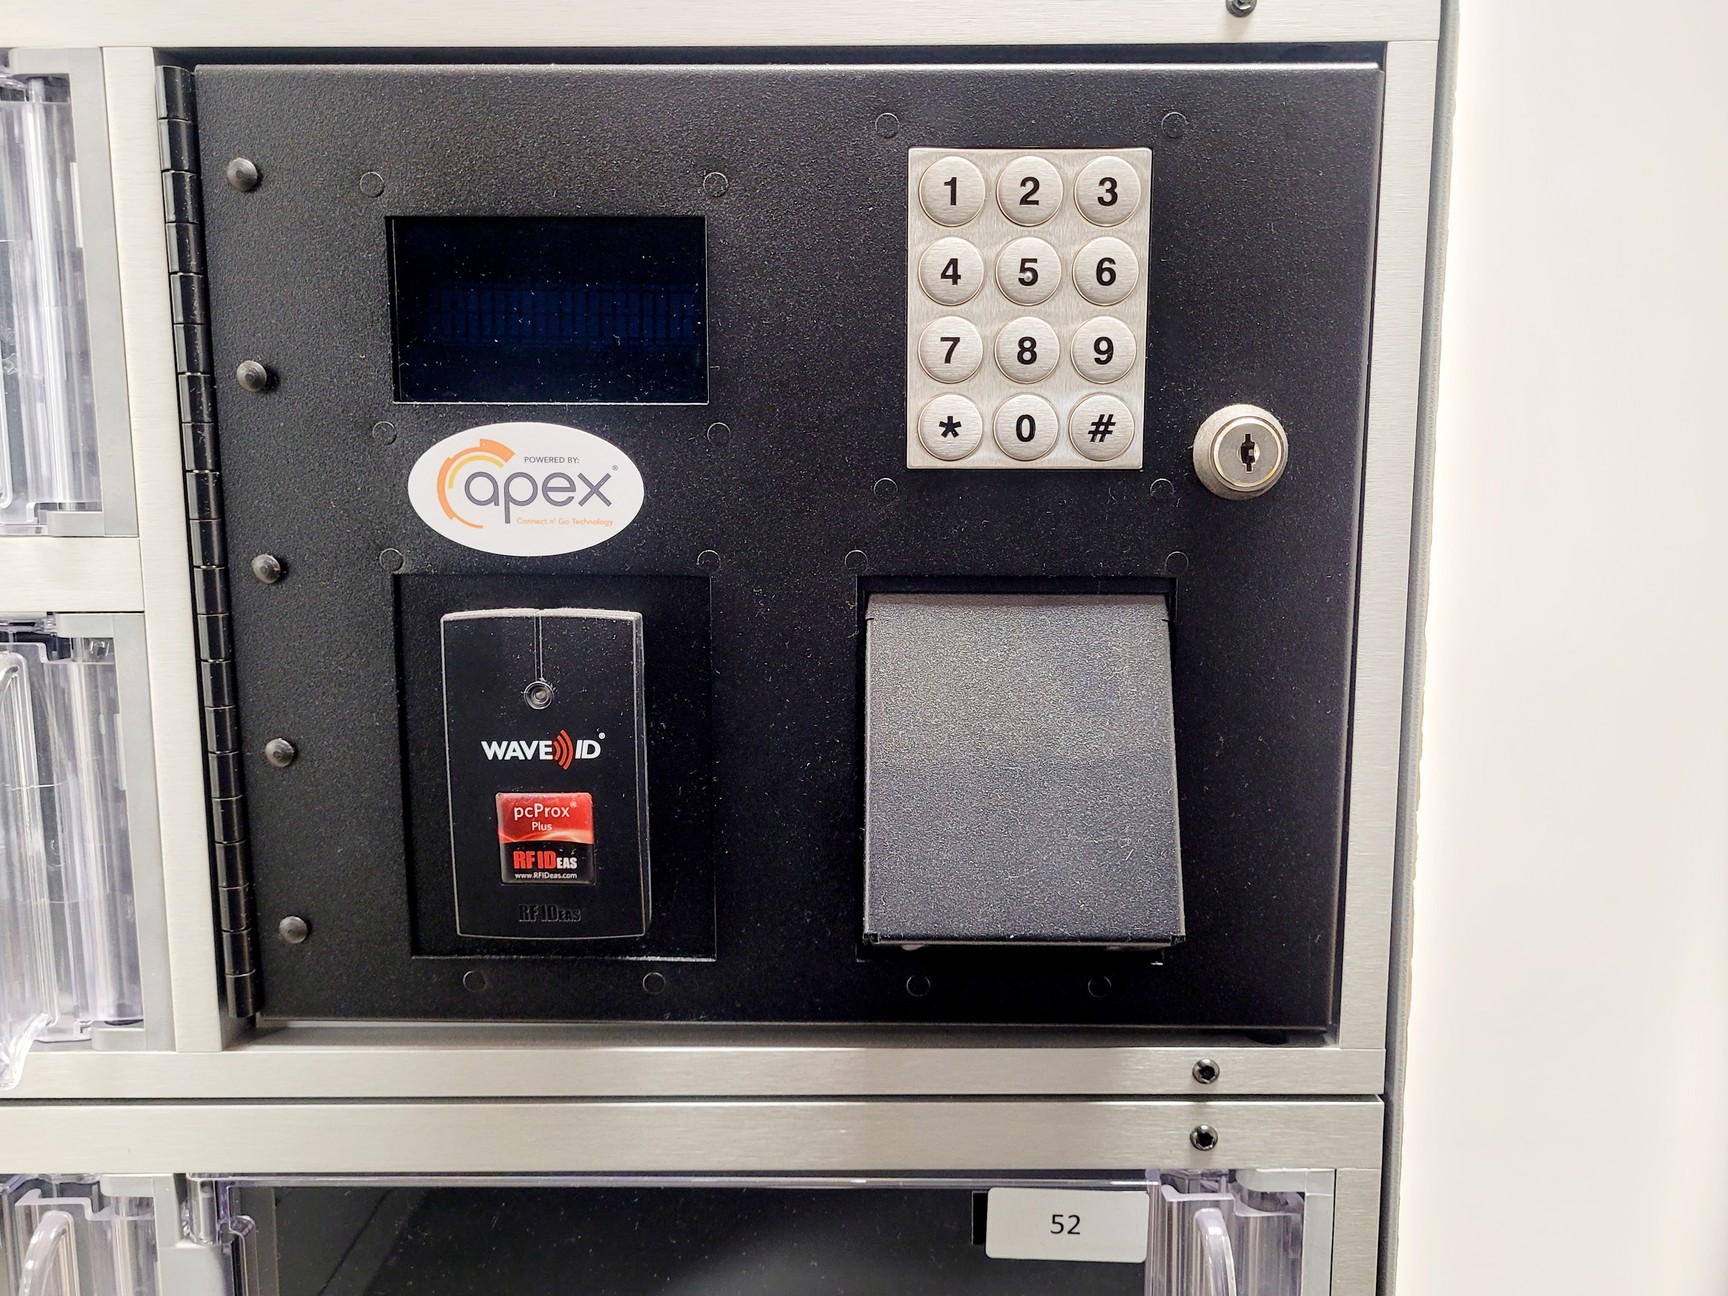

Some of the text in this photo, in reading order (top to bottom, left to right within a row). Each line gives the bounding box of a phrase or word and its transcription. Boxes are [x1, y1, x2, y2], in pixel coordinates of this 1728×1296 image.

[943, 176, 1119, 207] 1 2 3
[940, 257, 1117, 286] 4 5 6
[939, 337, 1115, 365] 7 8 9
[1015, 414, 1036, 442] 0
[1087, 414, 1116, 443] #
[524, 456, 580, 464] POWERED BY:
[572, 518, 614, 527] Technology
[481, 739, 602, 760] WAVE ID
[513, 803, 570, 820] pcProx
[531, 821, 553, 831] Plus
[1050, 1214, 1081, 1235] 52
